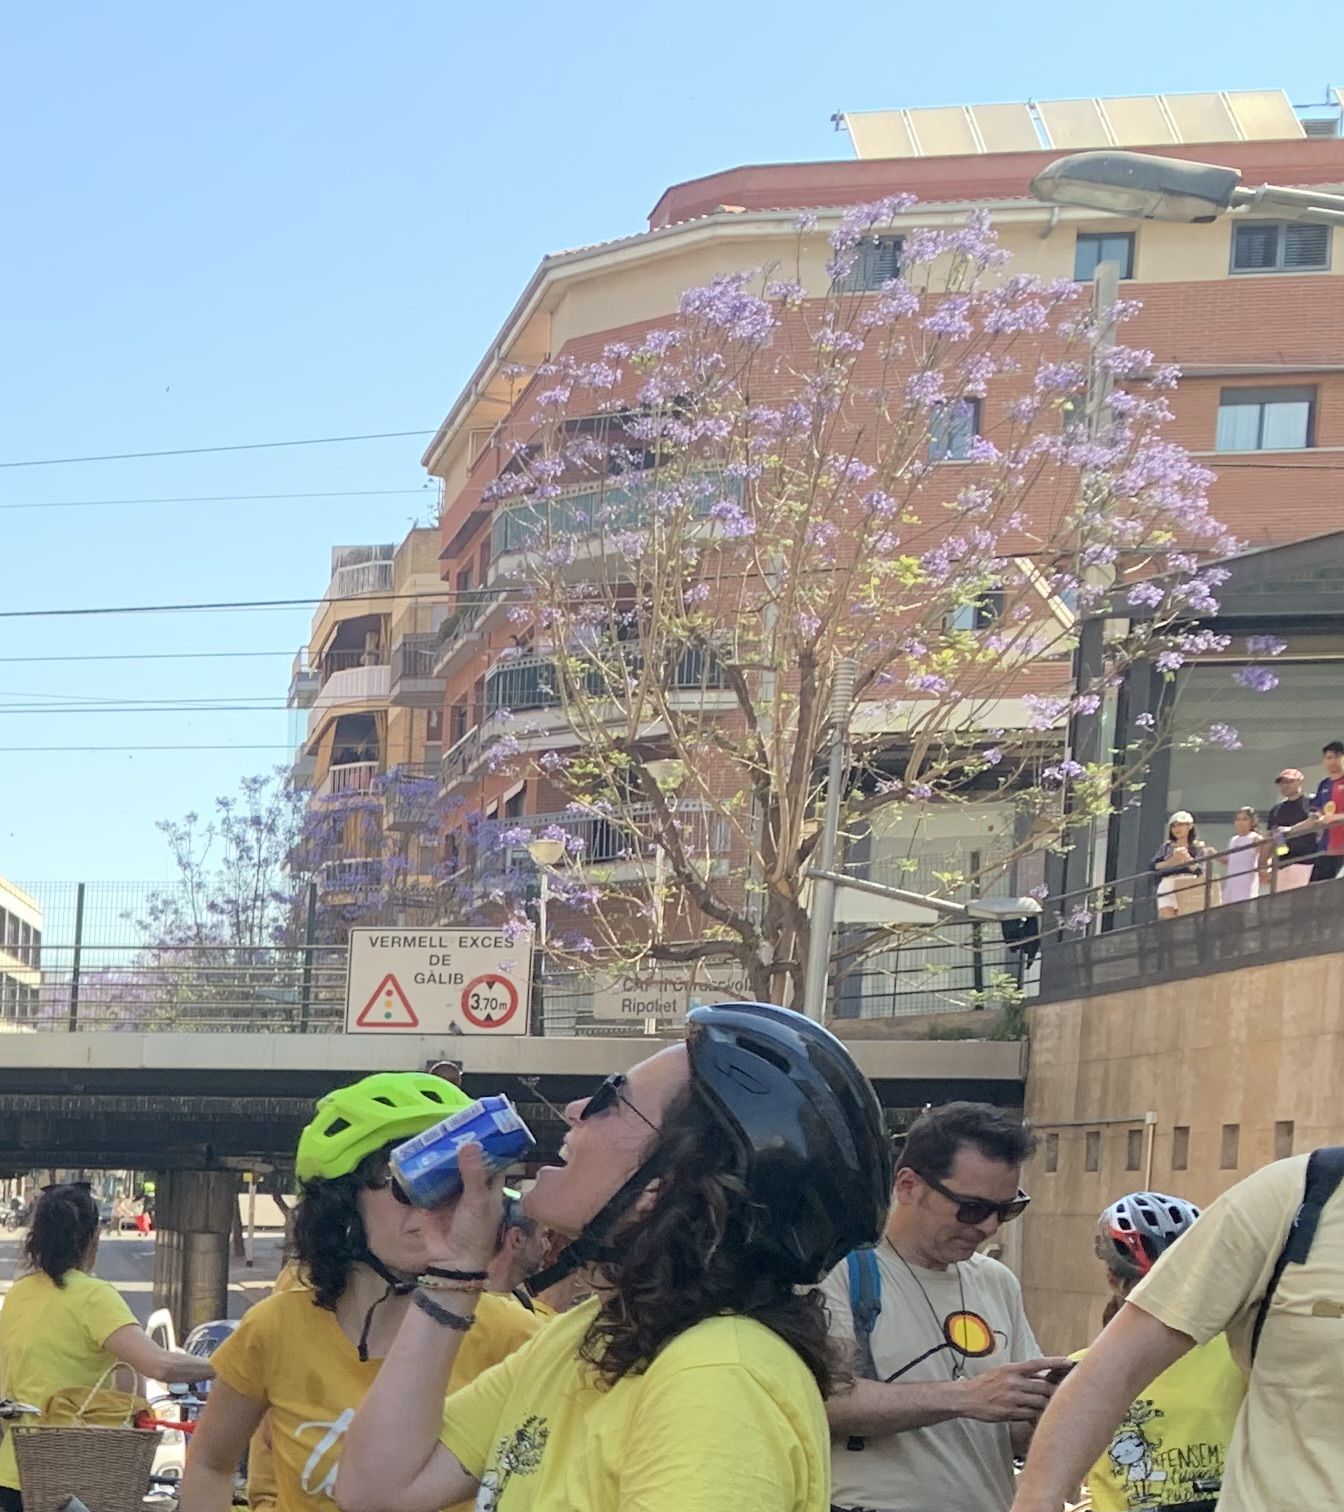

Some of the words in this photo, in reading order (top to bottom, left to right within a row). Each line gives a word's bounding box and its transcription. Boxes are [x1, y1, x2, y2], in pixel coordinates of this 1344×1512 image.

[369, 935, 448, 948] VERMELL
[428, 954, 451, 967] DE
[414, 970, 465, 985] GÀLIB
